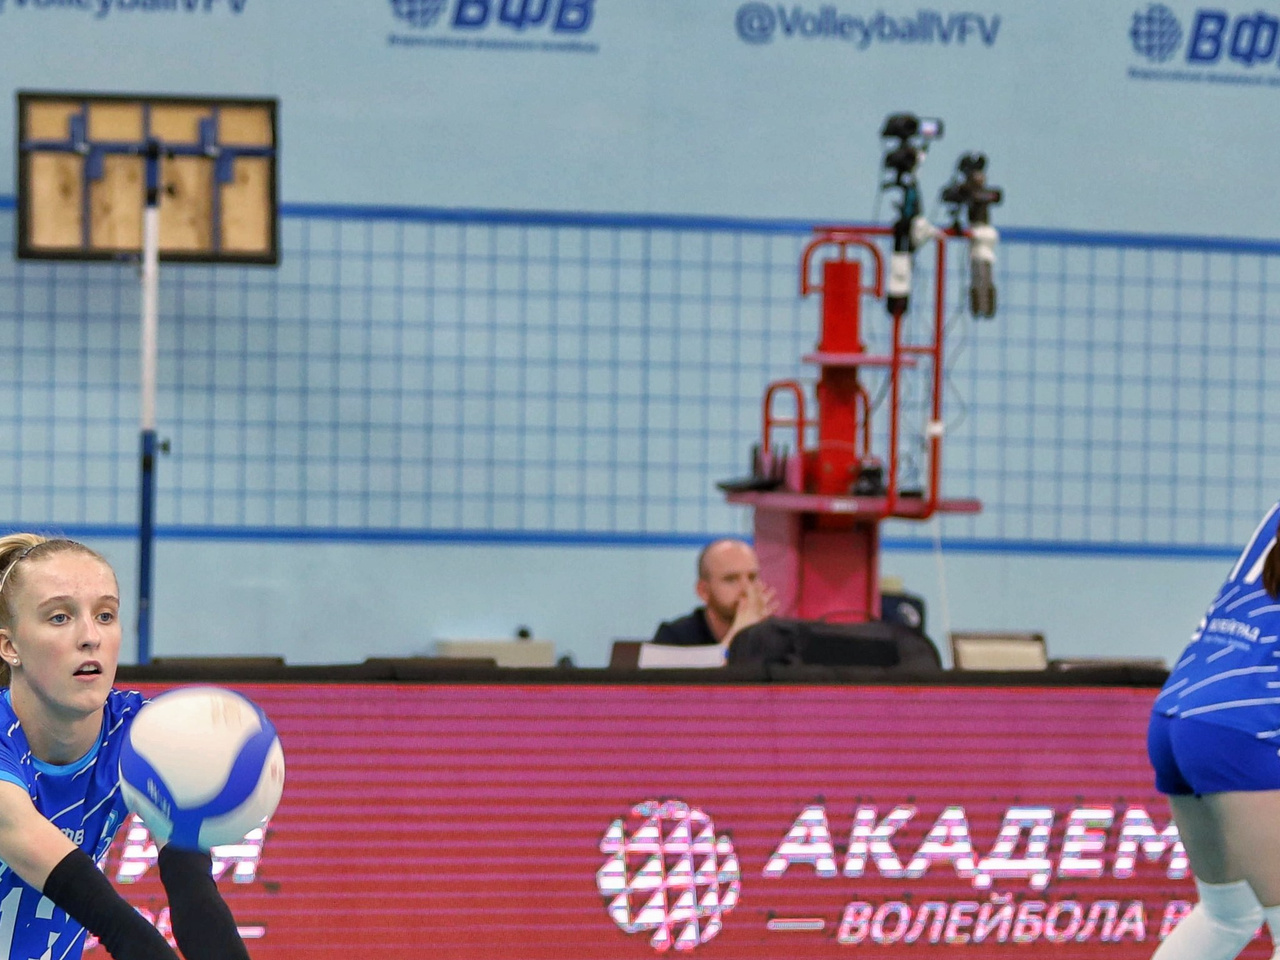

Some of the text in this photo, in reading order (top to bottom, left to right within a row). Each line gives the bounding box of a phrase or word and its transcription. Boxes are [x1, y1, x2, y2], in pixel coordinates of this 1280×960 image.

[735, 2, 1001, 50] @VolleyballVFV
[1187, 9, 1280, 67] ВФ
[762, 805, 1190, 889] АКАДЕМ
[837, 893, 1147, 944] ВОЛЕЙБОЛА
